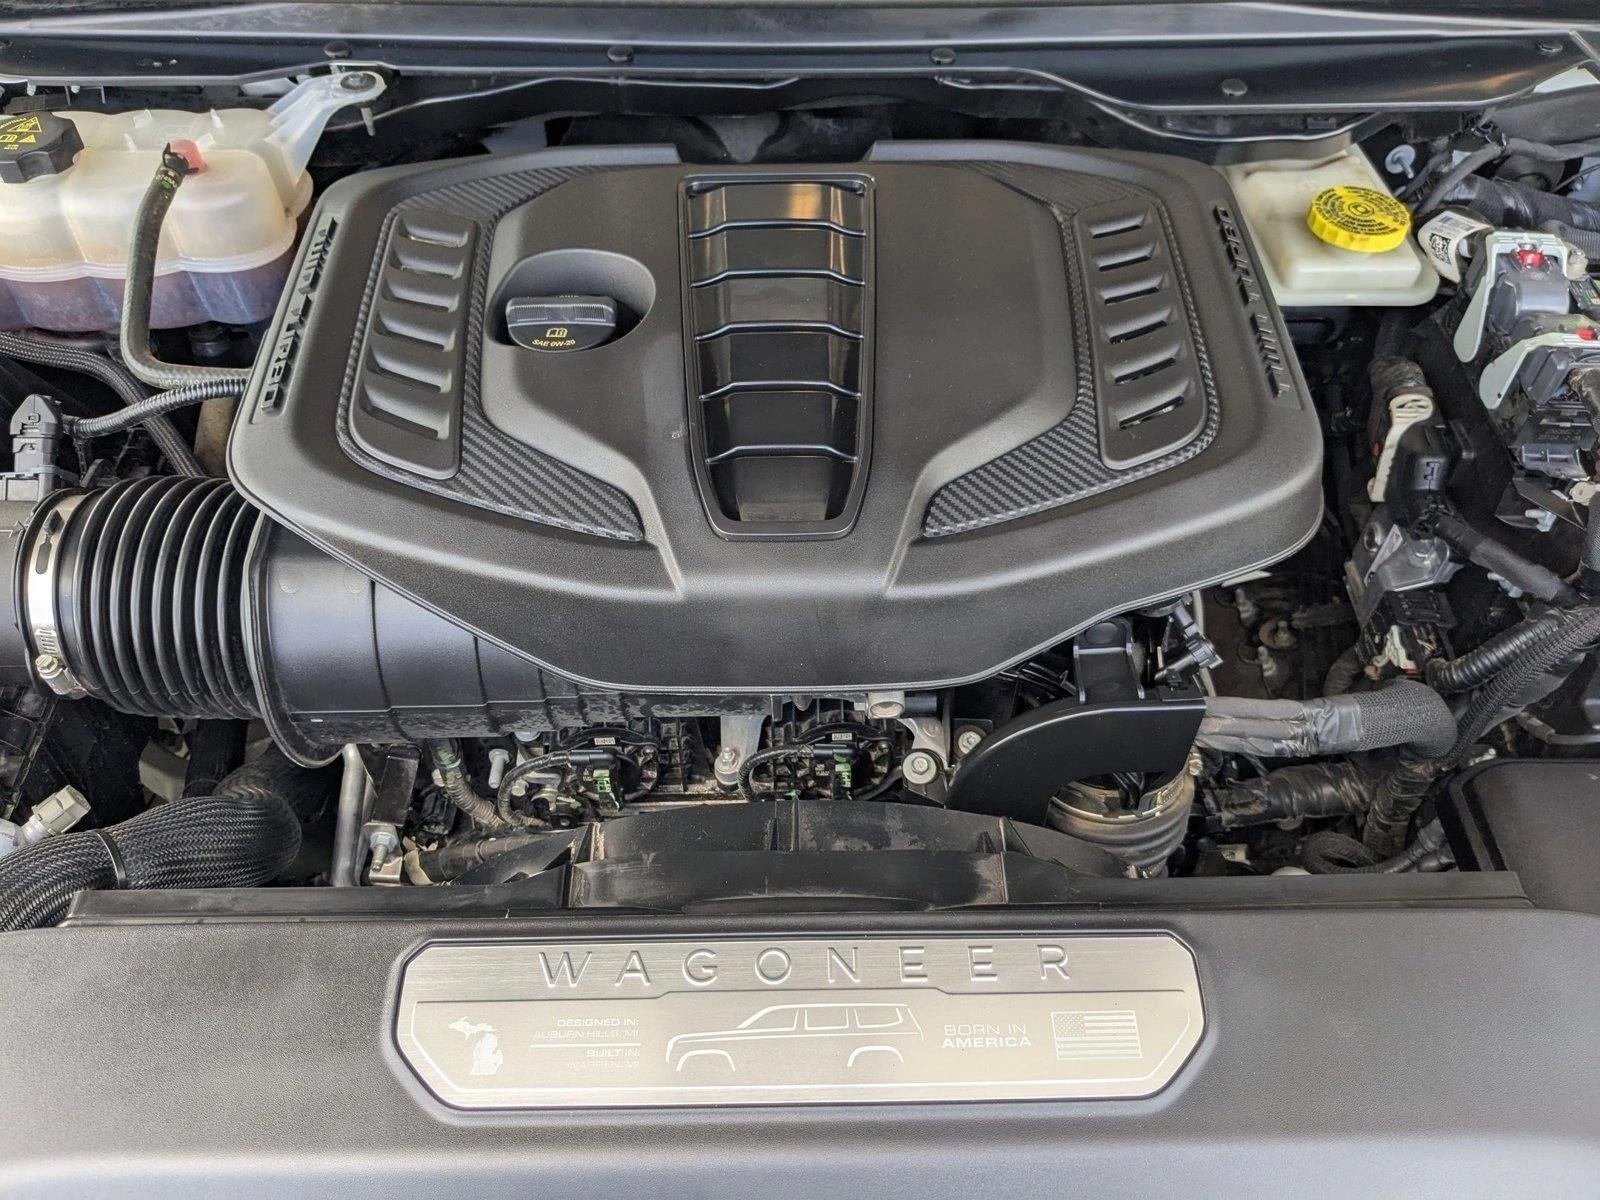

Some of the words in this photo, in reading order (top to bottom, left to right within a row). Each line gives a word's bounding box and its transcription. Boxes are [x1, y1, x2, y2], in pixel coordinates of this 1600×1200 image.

[1213, 206, 1260, 304] TURBO
[532, 339, 548, 347] SAE
[550, 339, 576, 347] 0W-20
[261, 295, 313, 412] TURBO
[538, 945, 1070, 988] WAGONEER
[557, 1018, 620, 1027] DESIGNED
[534, 1030, 584, 1039] AUBURN
[625, 1029, 639, 1037] MI
[944, 1024, 1000, 1035] BORN
[1008, 1023, 1026, 1035] IN
[942, 1037, 1032, 1048] AMERICA
[587, 1048, 620, 1057] BUILT
